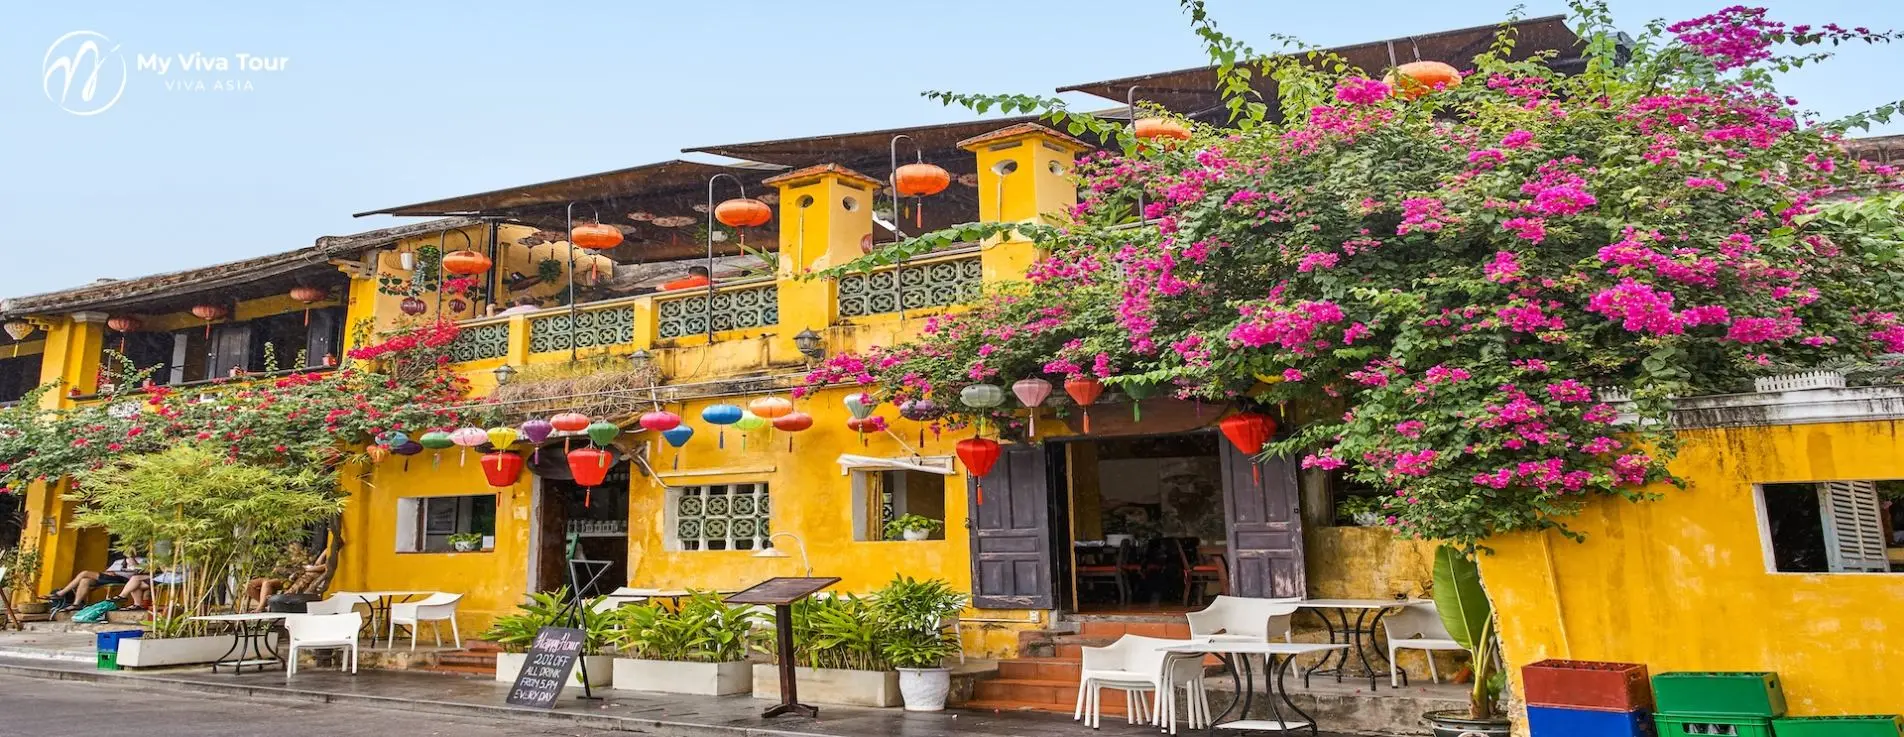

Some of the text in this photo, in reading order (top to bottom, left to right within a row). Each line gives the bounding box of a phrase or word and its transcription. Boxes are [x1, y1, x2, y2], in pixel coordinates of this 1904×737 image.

[558, 632, 581, 651] Hour
[524, 666, 562, 679] ALL DRINK
[519, 677, 540, 688] FROM
[513, 689, 555, 702] EVERY DAY
